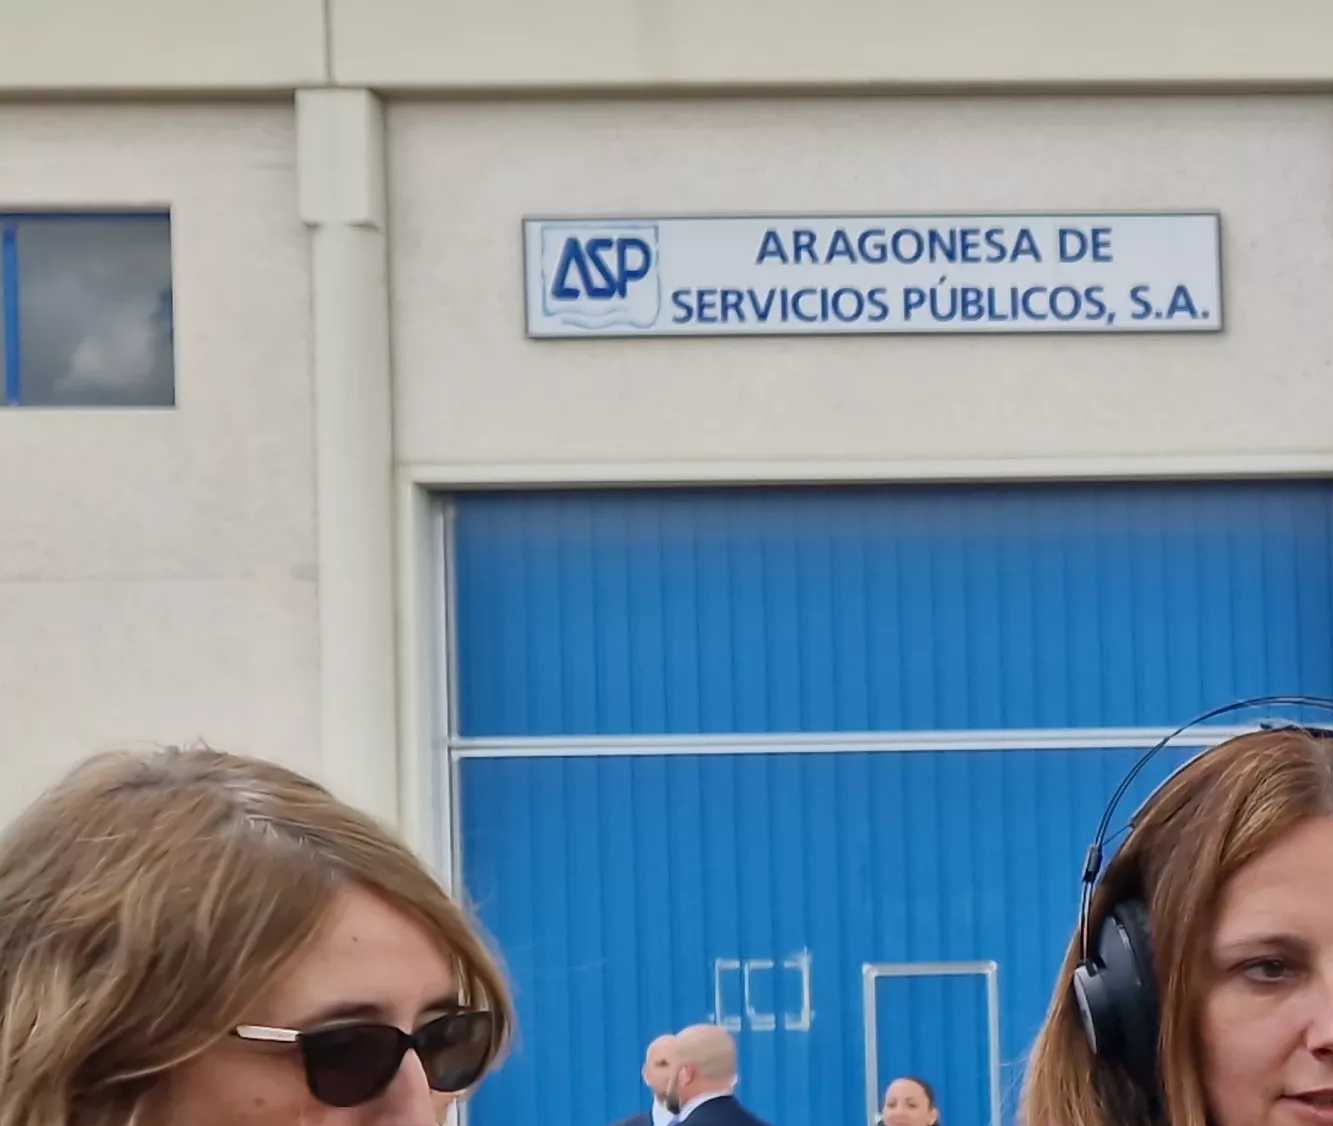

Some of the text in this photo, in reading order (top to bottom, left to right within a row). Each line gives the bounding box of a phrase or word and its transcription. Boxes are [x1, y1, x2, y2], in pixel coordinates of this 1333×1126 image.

[550, 237, 652, 300] ASP
[755, 227, 1113, 265] ARAGONESA DE
[671, 275, 1210, 325] SERVICIOS PÚBLICOS, S.A.
